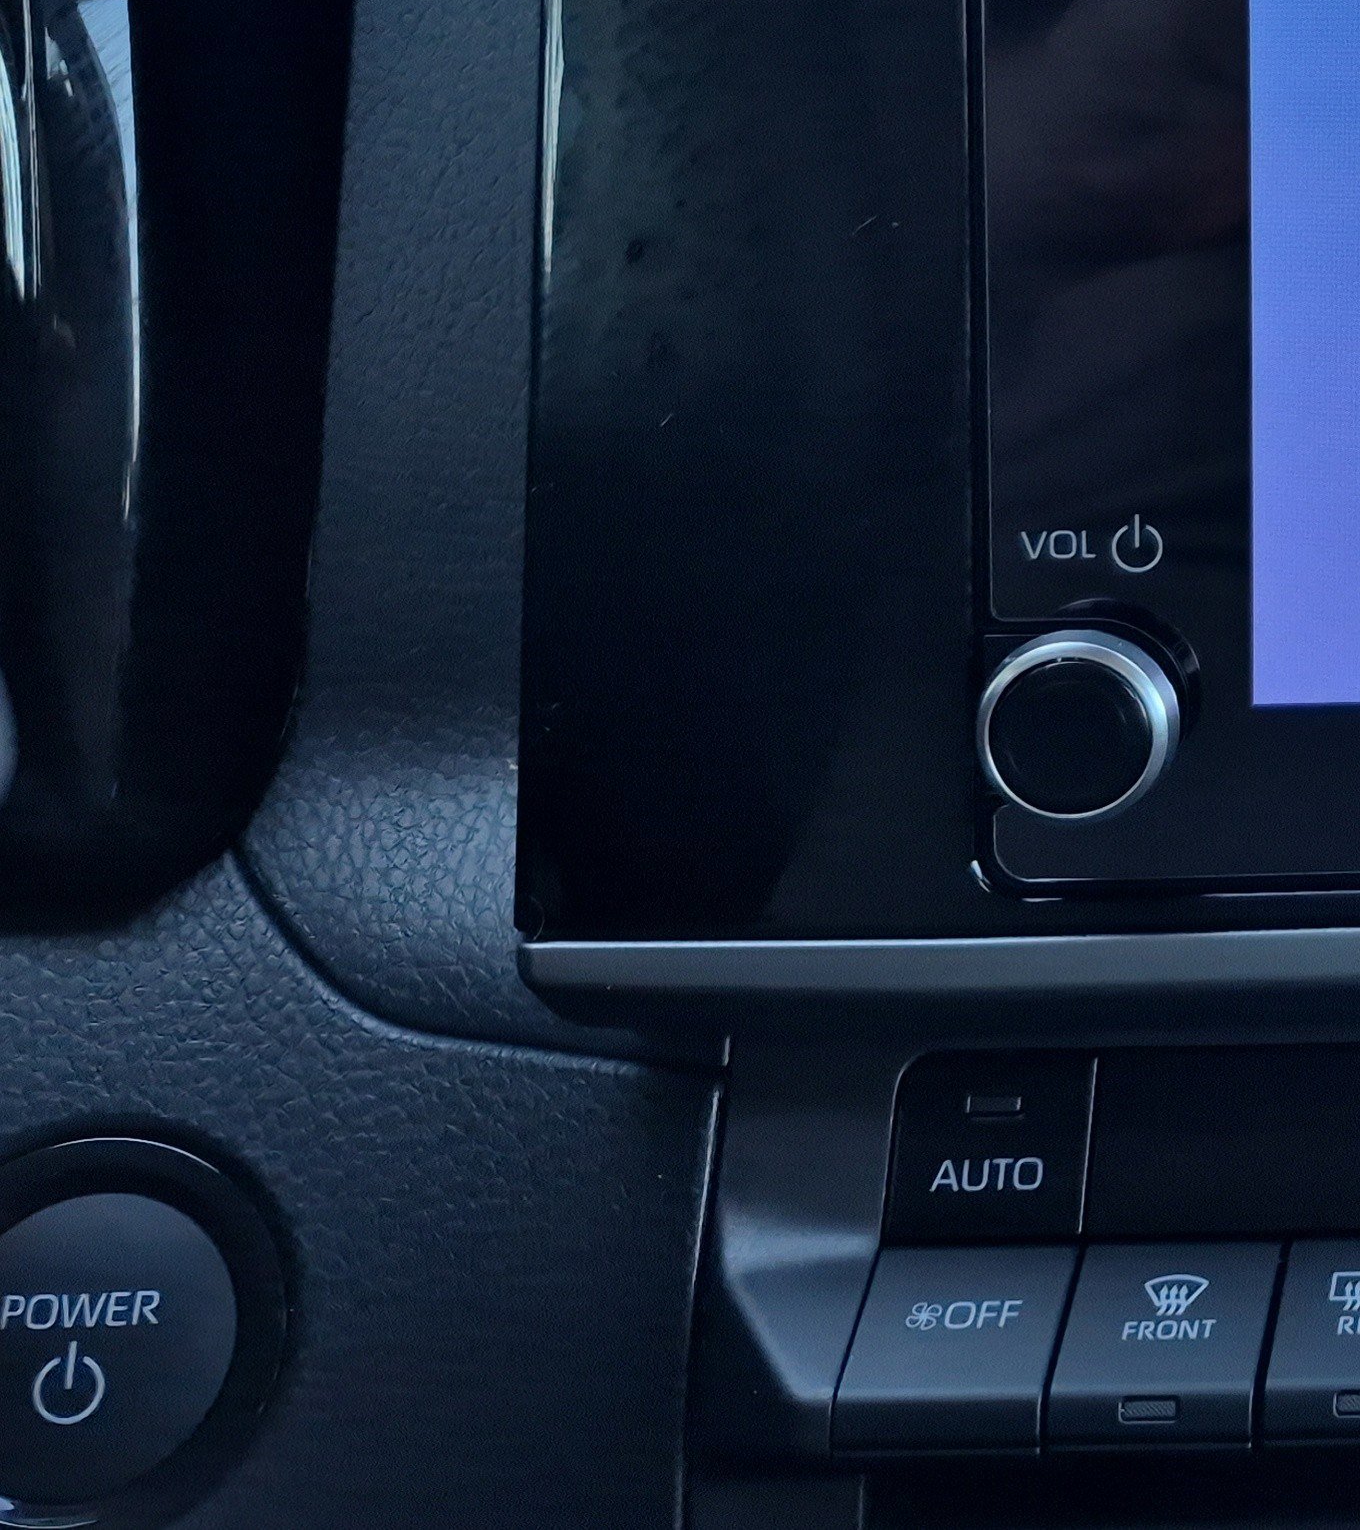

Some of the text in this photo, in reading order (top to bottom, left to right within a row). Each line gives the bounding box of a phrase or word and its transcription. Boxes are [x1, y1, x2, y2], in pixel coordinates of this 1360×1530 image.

[1020, 530, 1096, 560] VOL
[929, 1157, 1044, 1193] AUTO
[0, 1289, 161, 1330] POWER
[943, 1299, 1023, 1330] OFF
[1121, 1318, 1217, 1341] FRONT
